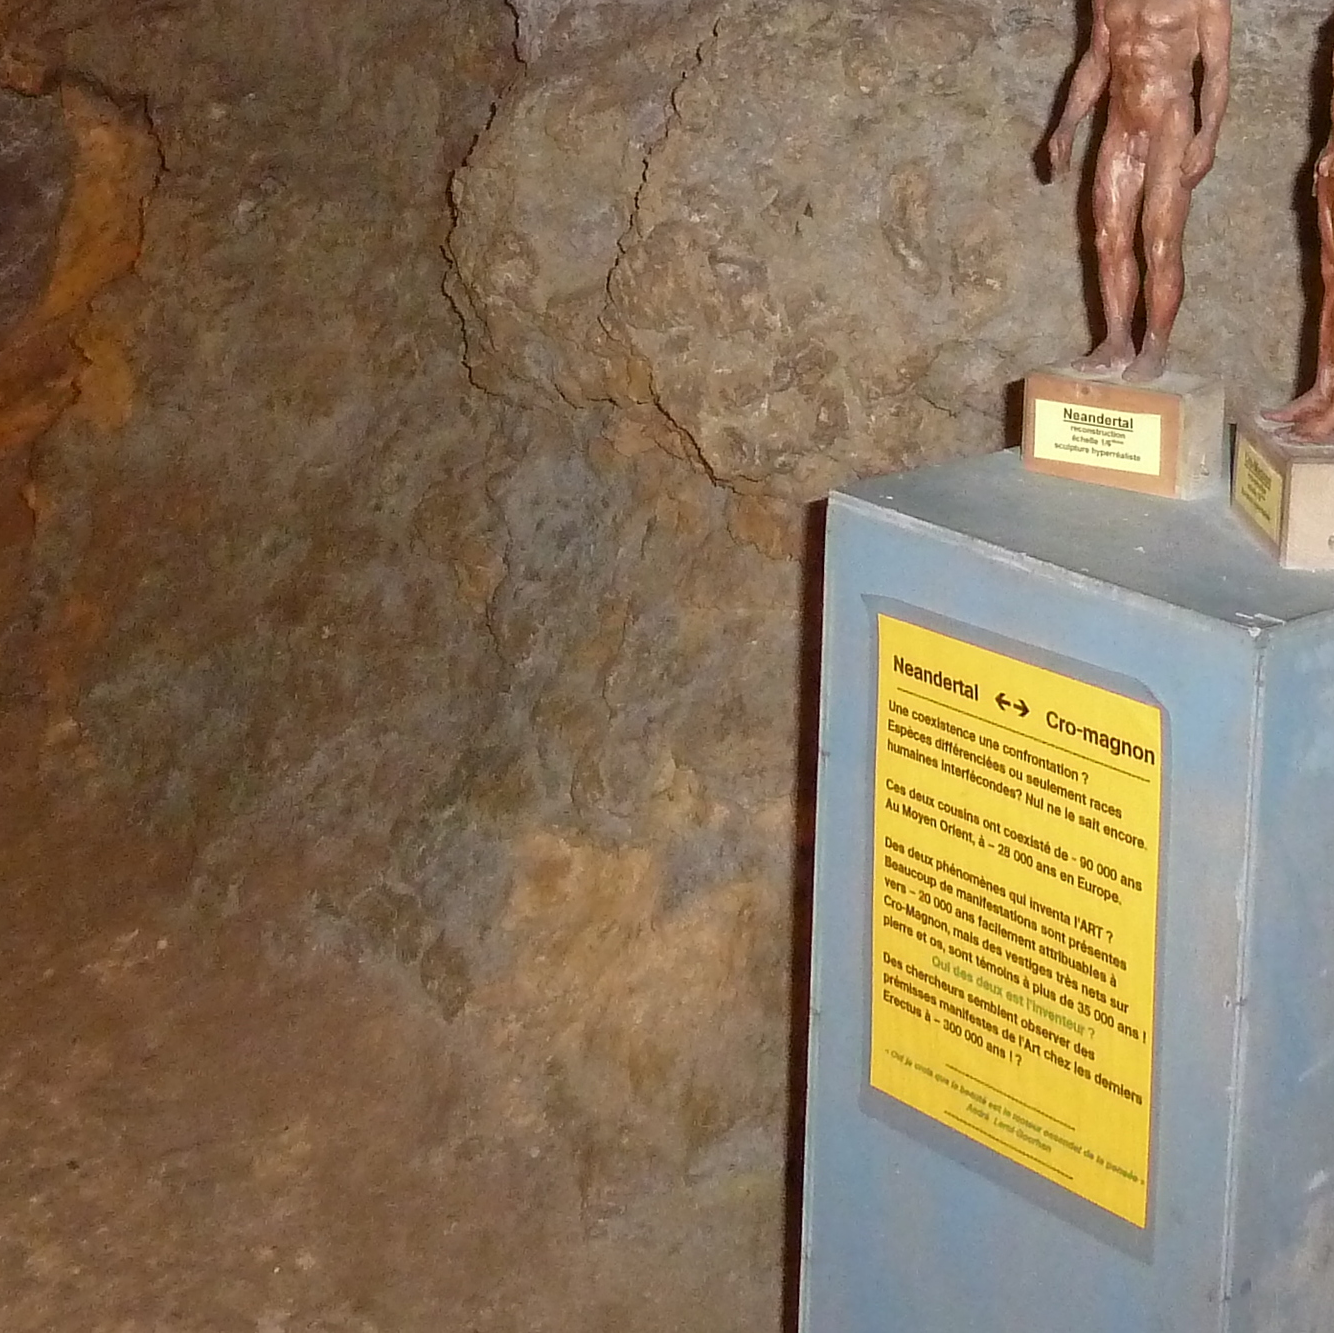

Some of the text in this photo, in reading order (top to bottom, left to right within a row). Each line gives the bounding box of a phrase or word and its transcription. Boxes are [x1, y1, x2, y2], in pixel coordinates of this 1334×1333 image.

[1063, 407, 1133, 429] Neandertal
[1070, 426, 1125, 439] reconstruction
[888, 699, 909, 716] Une
[911, 710, 975, 742] coexistence
[978, 734, 999, 750] une
[1002, 744, 1078, 781] confrontation
[893, 654, 1154, 765] Neandertal Cro-magnon
[887, 718, 1121, 819] Espèces différenciées ou seulement races
[887, 738, 1146, 849] humaines interfécondes? Nul ne le sait encore.
[884, 835, 904, 854] Des
[907, 846, 933, 866] deux
[935, 859, 1005, 897] phénomènes
[1008, 891, 1026, 906] qui
[1029, 896, 1070, 925] inventa
[1073, 915, 1103, 938] l'ART
[885, 778, 906, 796] Ces
[908, 787, 934, 807] deux
[937, 800, 979, 825] cousins
[982, 818, 1000, 834] ont
[1003, 827, 1050, 854] coexisté
[1053, 846, 1068, 861] de
[1079, 856, 1093, 871] 90
[1096, 862, 1117, 880] 000
[1120, 874, 1142, 891] ans
[885, 797, 899, 813] Au
[902, 803, 936, 828] Moyen
[939, 819, 975, 846] Orient,
[978, 834, 985, 848] à
[997, 843, 1010, 858] 28
[1013, 849, 1033, 867] 000
[1035, 861, 1056, 877] ans
[1059, 871, 1074, 885] en
[1077, 875, 1121, 905] Europe.
[883, 894, 1129, 1013] Cro-Magnon, mais des vestiges très nets sur
[884, 854, 1126, 970] Beaucoup de manifestations sont présentes
[884, 876, 906, 894] vers
[918, 889, 931, 904] 20
[933, 896, 952, 913] 000
[954, 907, 975, 924] ans
[977, 915, 1035, 951] facilement
[1038, 944, 1106, 982] attribuables
[1109, 973, 1116, 987] à
[883, 915, 913, 936] pierre
[916, 930, 927, 943] et
[929, 936, 945, 953] os,
[948, 944, 972, 963] sont
[975, 954, 1019, 984] témoins
[1022, 975, 1029, 989] à
[1032, 982, 1056, 1001] plus
[1059, 993, 1074, 1009] de
[1077, 1001, 1090, 1016] 35
[1093, 1008, 1114, 1027] 000
[1117, 1022, 1139, 1039] ans
[883, 951, 1094, 1060] Des chercheurs semblent observer des
[883, 988, 921, 1017] Erectus
[924, 1008, 931, 1022] à
[943, 1018, 962, 1036] 300
[964, 1028, 983, 1047] 000
[985, 1041, 1005, 1058] ans
[931, 955, 950, 973] Qui
[952, 965, 973, 982] des
[975, 975, 1002, 998] deux
[1005, 990, 1023, 1006] est
[1026, 996, 1085, 1036] l'inventeur
[883, 972, 1142, 1105] prémisses manifestes de l'Art chez les derniers
